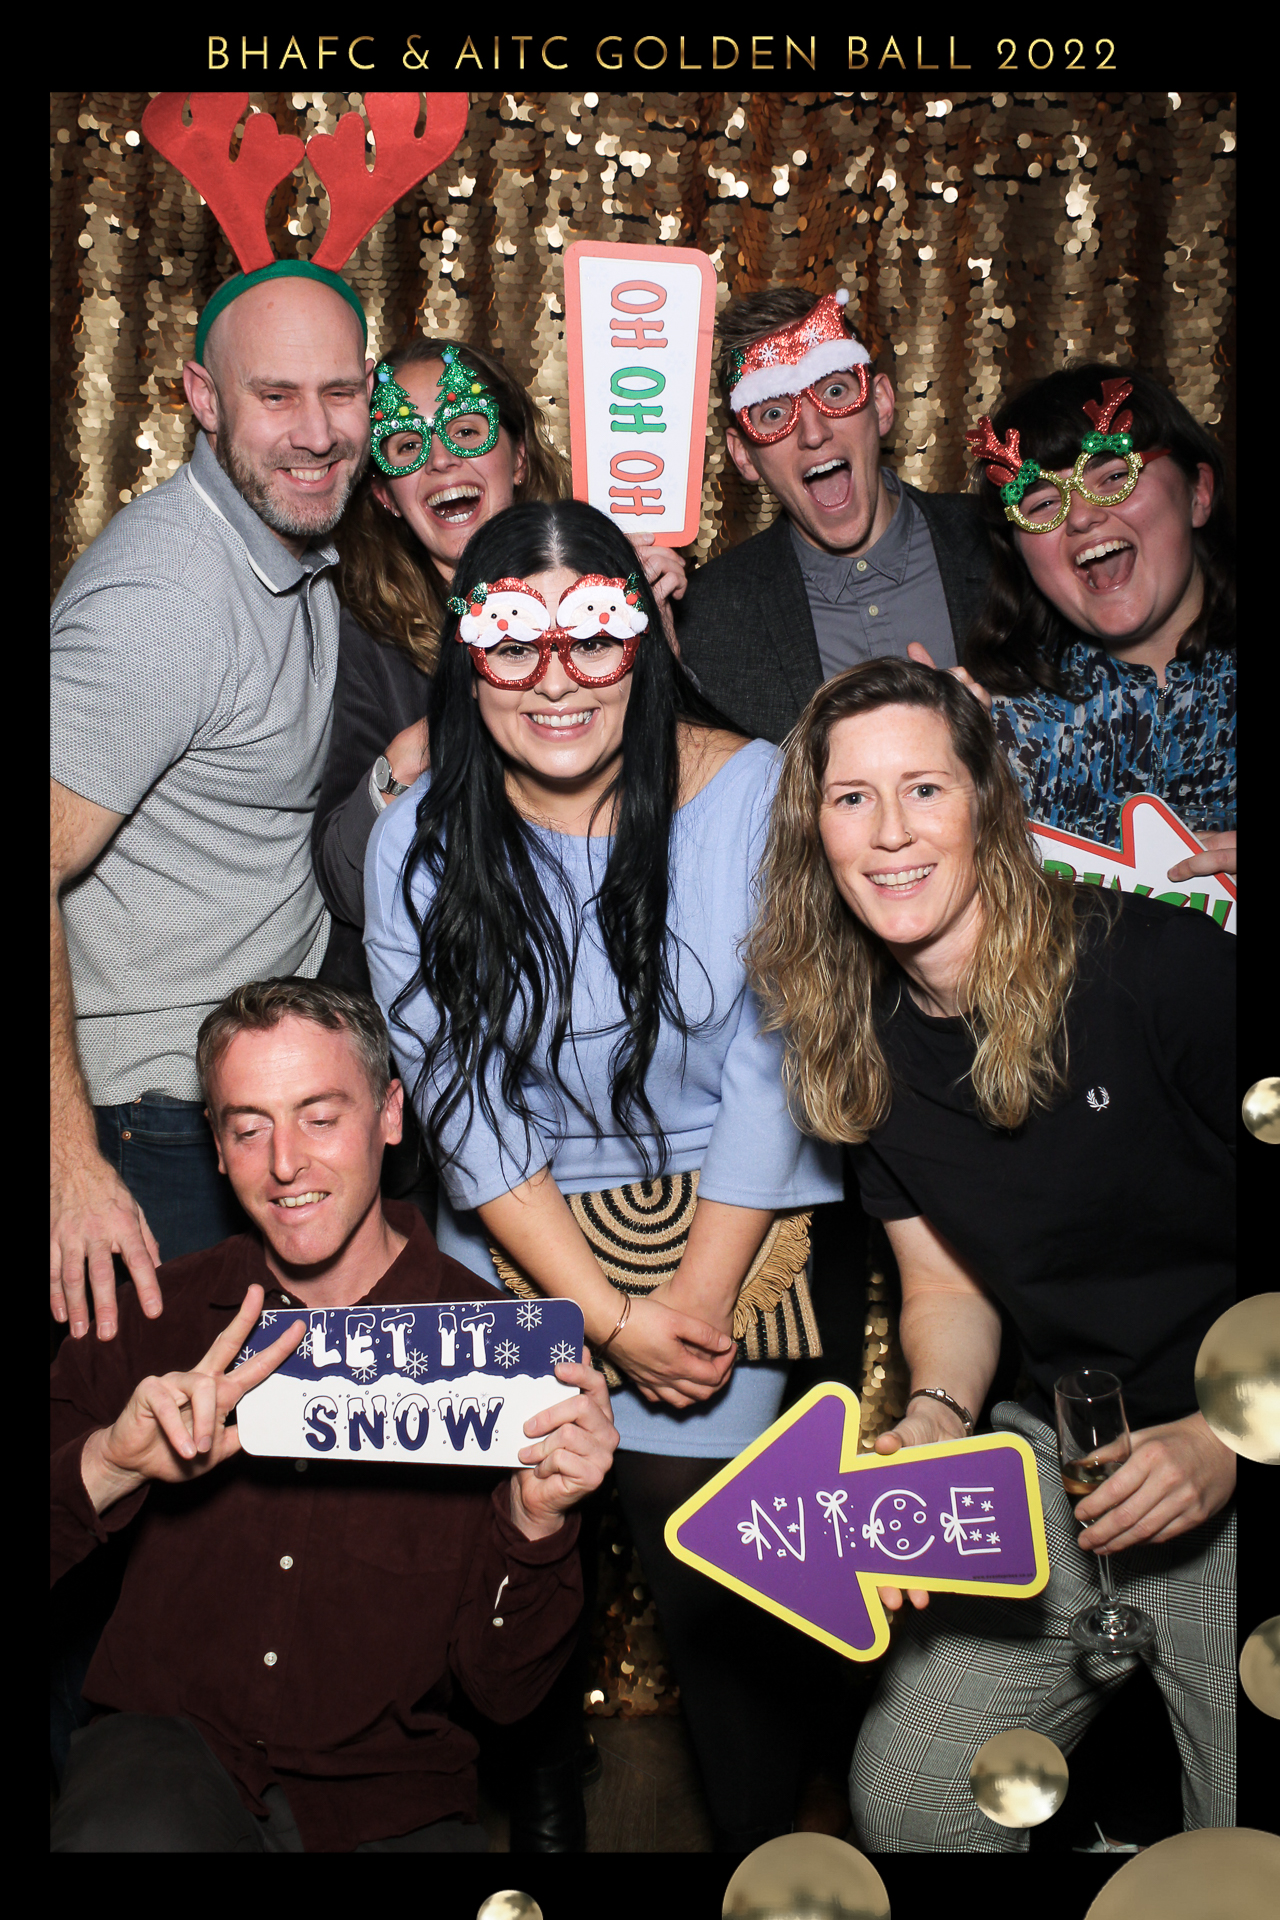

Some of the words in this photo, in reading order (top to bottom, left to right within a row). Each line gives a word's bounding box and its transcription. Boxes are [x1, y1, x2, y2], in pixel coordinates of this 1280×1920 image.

[609, 279, 668, 350] HO
[609, 366, 667, 434] HO
[609, 450, 666, 516] HO
[309, 1310, 416, 1368] LET
[438, 1312, 496, 1368] IT
[303, 1393, 505, 1452] SNOW
[737, 1486, 1002, 1562] NICE
